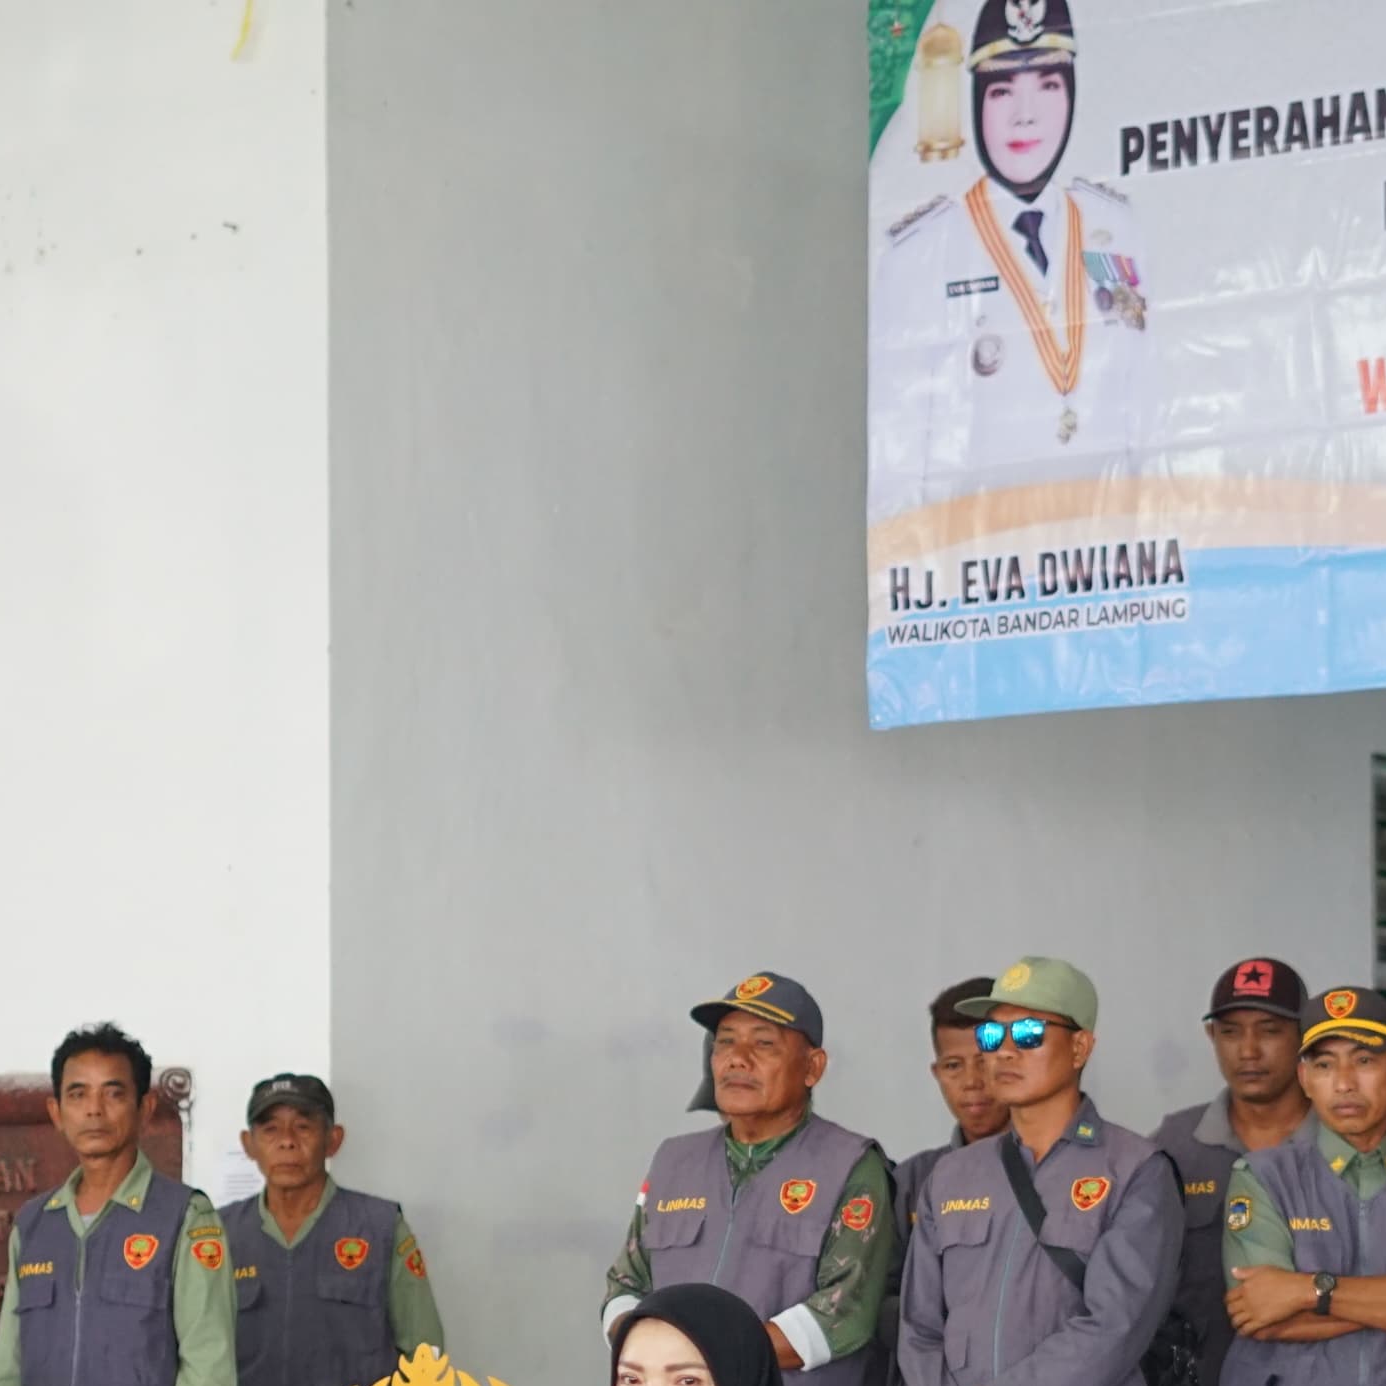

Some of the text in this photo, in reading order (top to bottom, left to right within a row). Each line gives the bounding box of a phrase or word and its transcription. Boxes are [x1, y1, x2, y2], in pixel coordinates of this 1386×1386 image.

[961, 555, 1026, 604] EVA
[1038, 539, 1185, 597] DWIANA
[888, 598, 1187, 645] WALIKOTA BANDAR LAMPUNG
[1185, 1180, 1216, 1194] MAS
[656, 1197, 707, 1212] LINMAS
